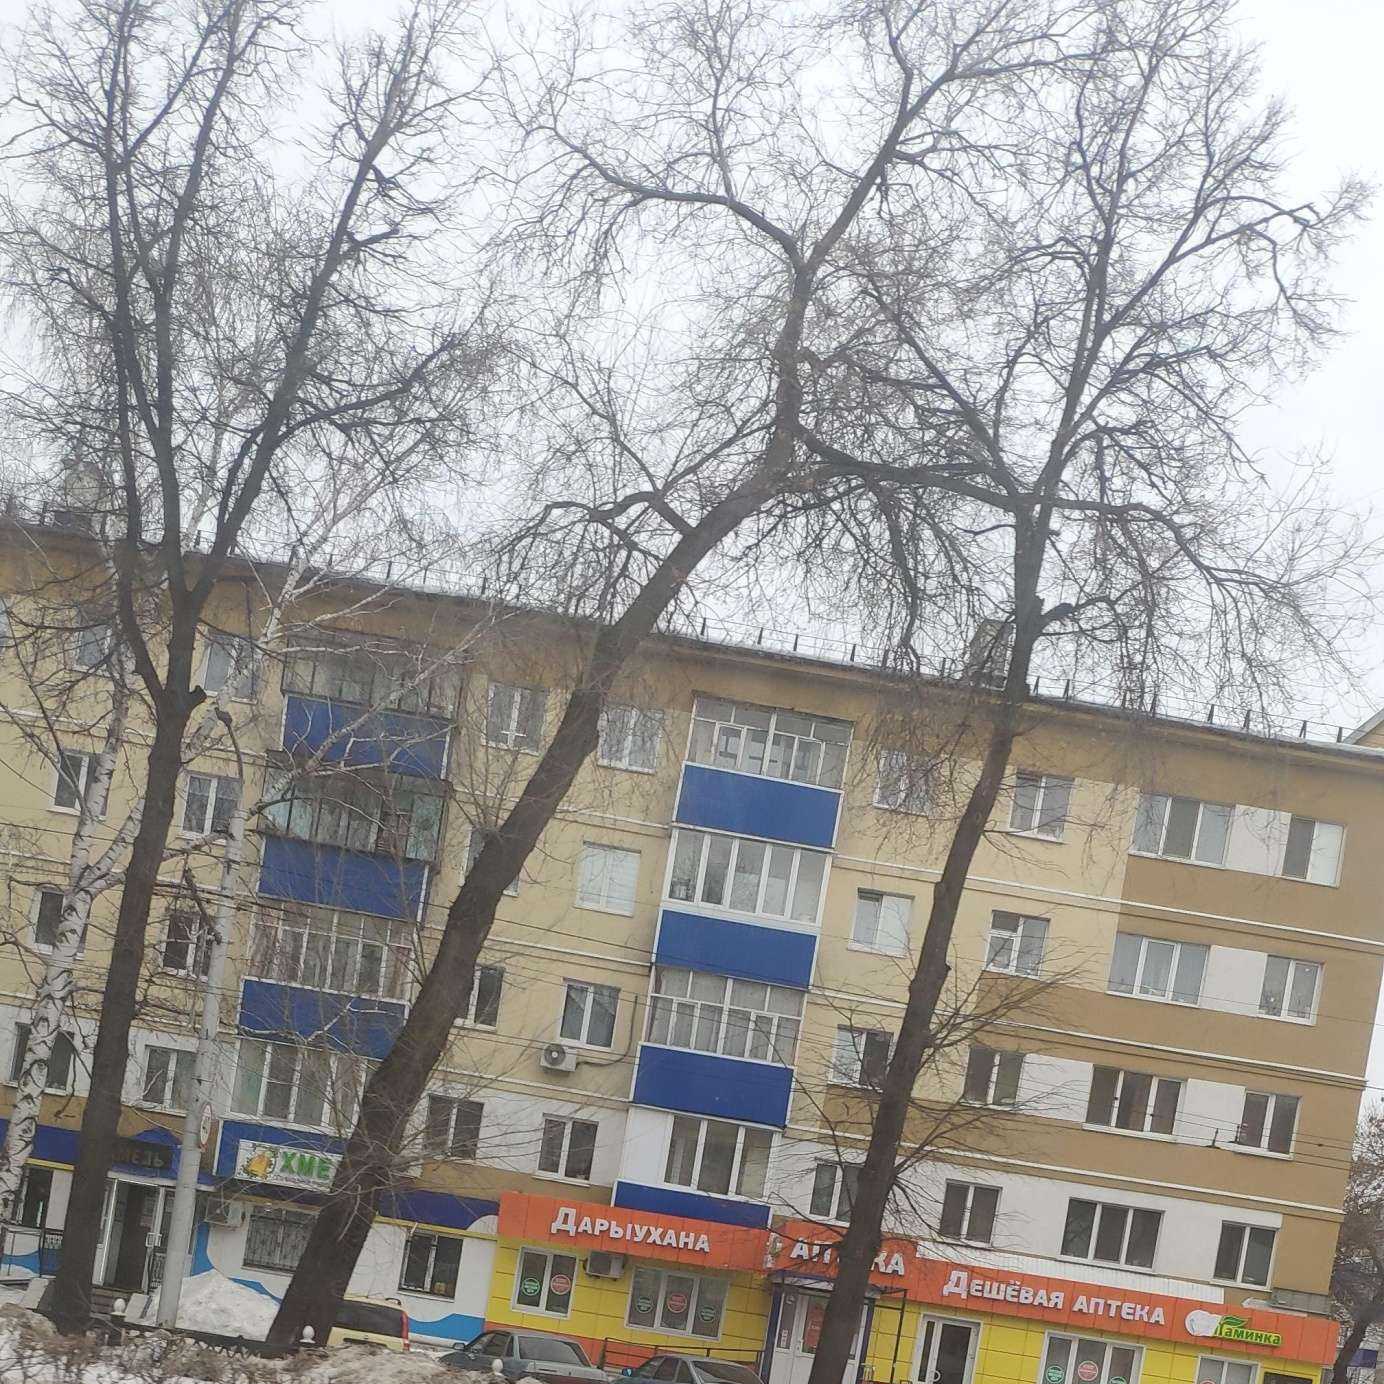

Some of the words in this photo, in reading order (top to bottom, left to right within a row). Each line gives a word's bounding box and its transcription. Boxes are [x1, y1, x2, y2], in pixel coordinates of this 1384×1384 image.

[551, 1206, 710, 1253] ДАРЫУХАНА
[790, 1237, 905, 1276] АПКА
[942, 1270, 1065, 1310] ДЕШЁВАЯ
[1071, 1295, 1166, 1326] АПТЕКА
